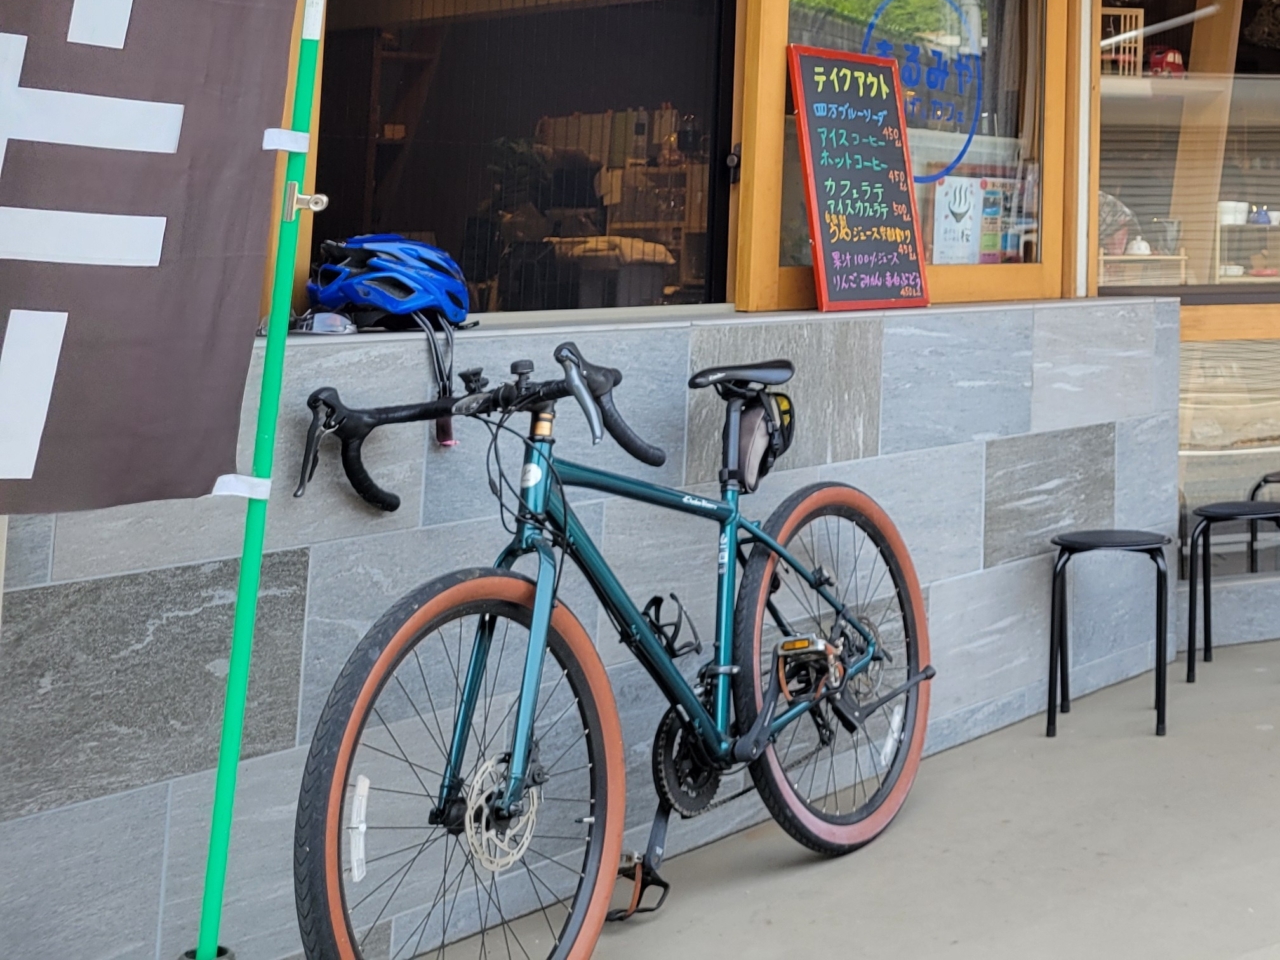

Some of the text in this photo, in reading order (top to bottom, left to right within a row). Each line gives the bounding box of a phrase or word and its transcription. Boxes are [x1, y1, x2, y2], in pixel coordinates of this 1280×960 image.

[813, 66, 890, 100] テイクアウト
[813, 102, 888, 127] 四万ブルーソーダ
[817, 127, 886, 149] アイスコーヒー
[882, 125, 899, 141] 450
[820, 149, 888, 171] ホットコーヒー
[888, 169, 905, 184] 450
[824, 176, 884, 203] カフェラテ
[827, 198, 889, 221] アイスカフェラテ
[892, 200, 908, 217] 500
